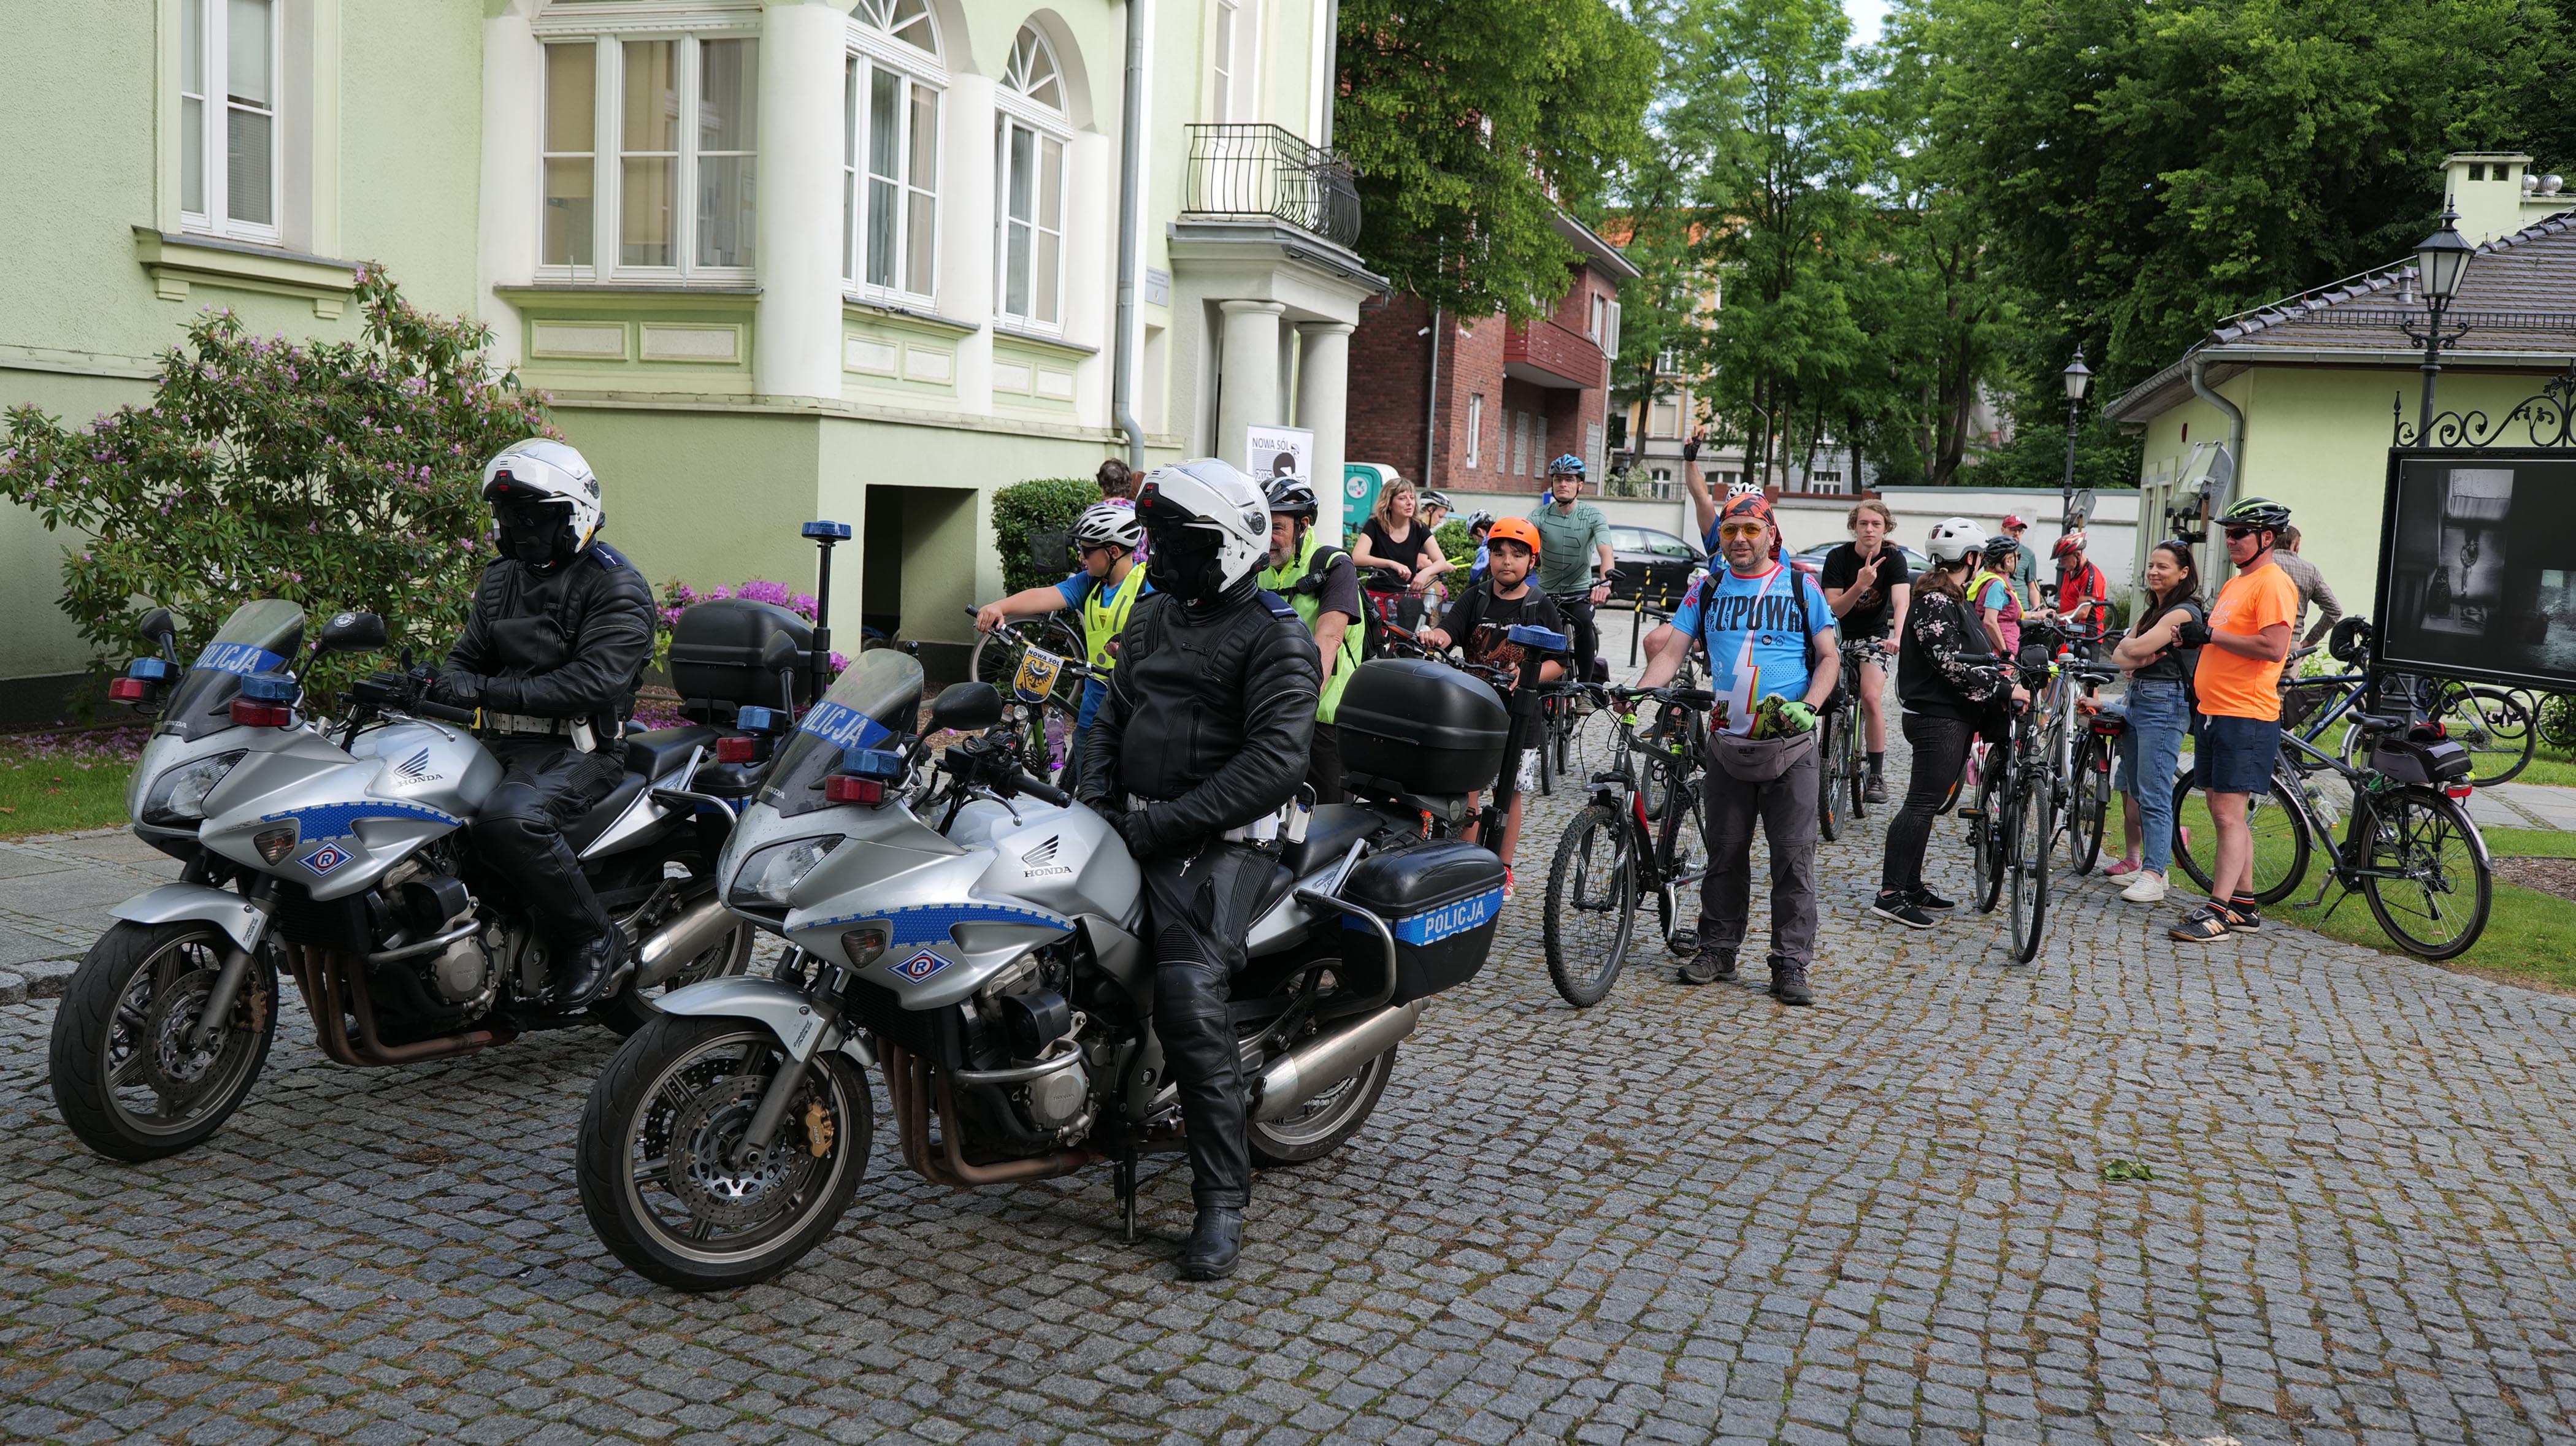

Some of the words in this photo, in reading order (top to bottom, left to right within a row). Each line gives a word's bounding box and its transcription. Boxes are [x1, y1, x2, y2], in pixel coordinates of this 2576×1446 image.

[1252, 437, 1275, 449] NOWA
[1276, 437, 1289, 451] SÓL
[194, 644, 263, 673] OLICJA
[1028, 649, 1047, 661] NOWA
[2323, 700, 2348, 723] NAVIGATOR
[799, 702, 869, 748] OLICJA
[397, 774, 444, 787] HONDA
[320, 854, 332, 865] R
[1023, 866, 1073, 878] HONDA
[1425, 900, 1484, 938] POLICJA
[914, 961, 927, 973] R
[793, 1019, 810, 1047] Combined
[797, 1020, 813, 1049] ABS
